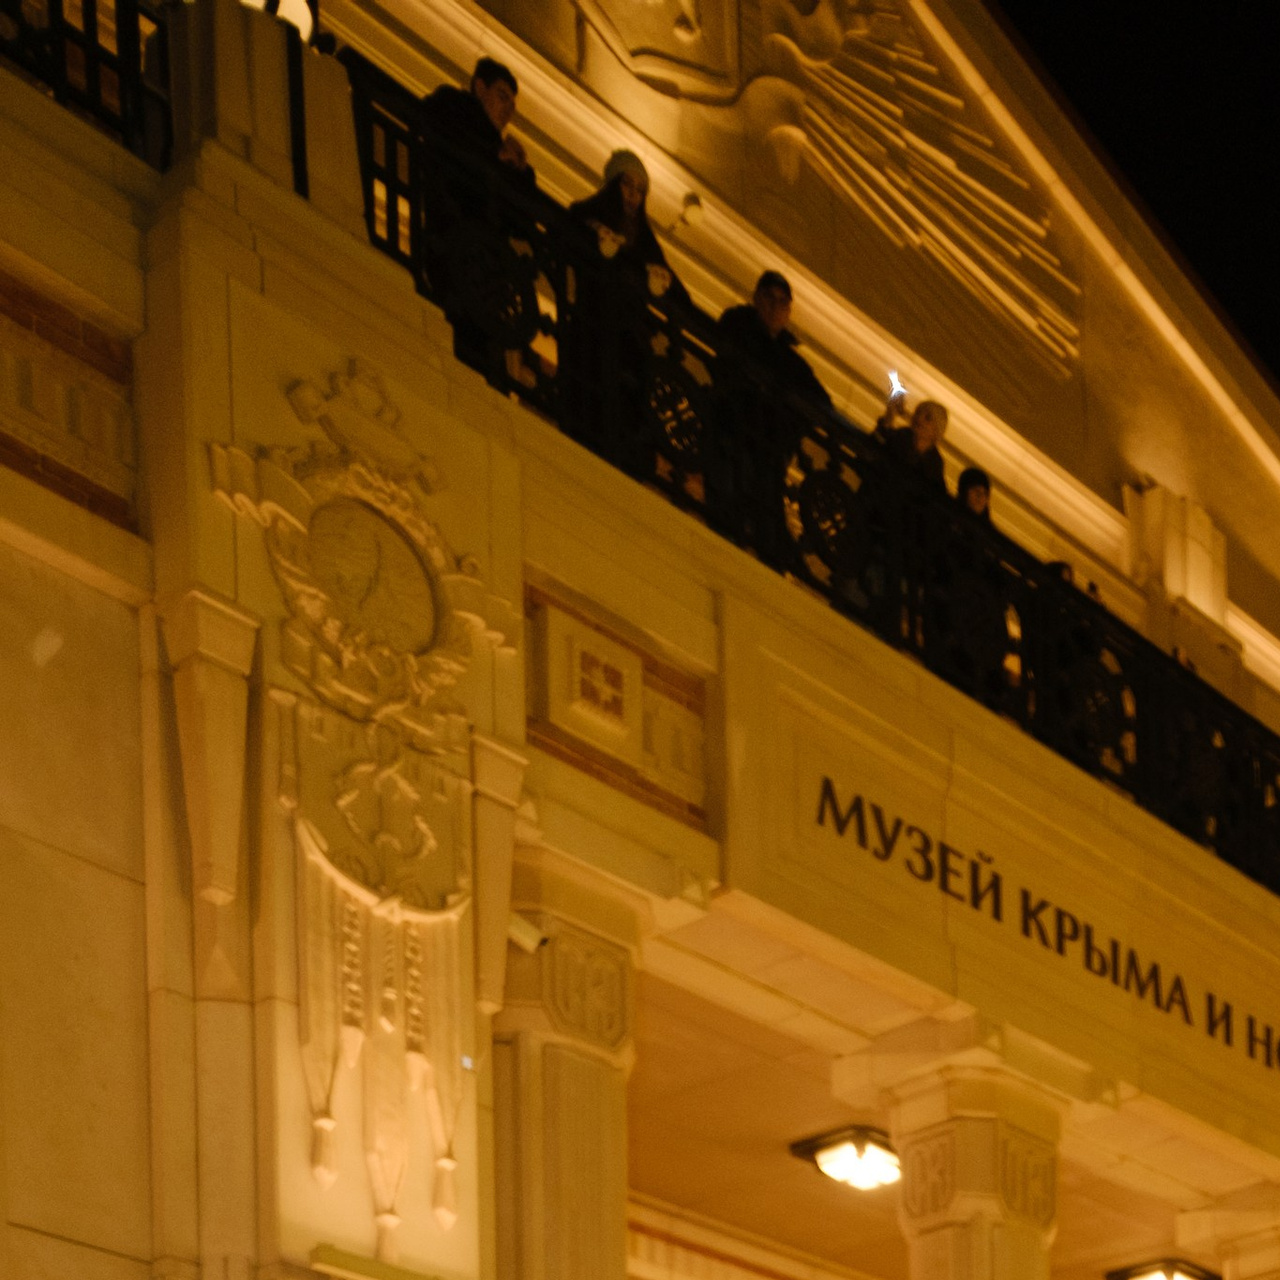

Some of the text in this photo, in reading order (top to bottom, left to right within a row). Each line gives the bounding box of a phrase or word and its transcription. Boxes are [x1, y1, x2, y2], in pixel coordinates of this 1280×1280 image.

[816, 776, 1004, 923] МУЗЕЙ
[1019, 888, 1194, 1026] КРЫМА
[1205, 992, 1234, 1047] И
